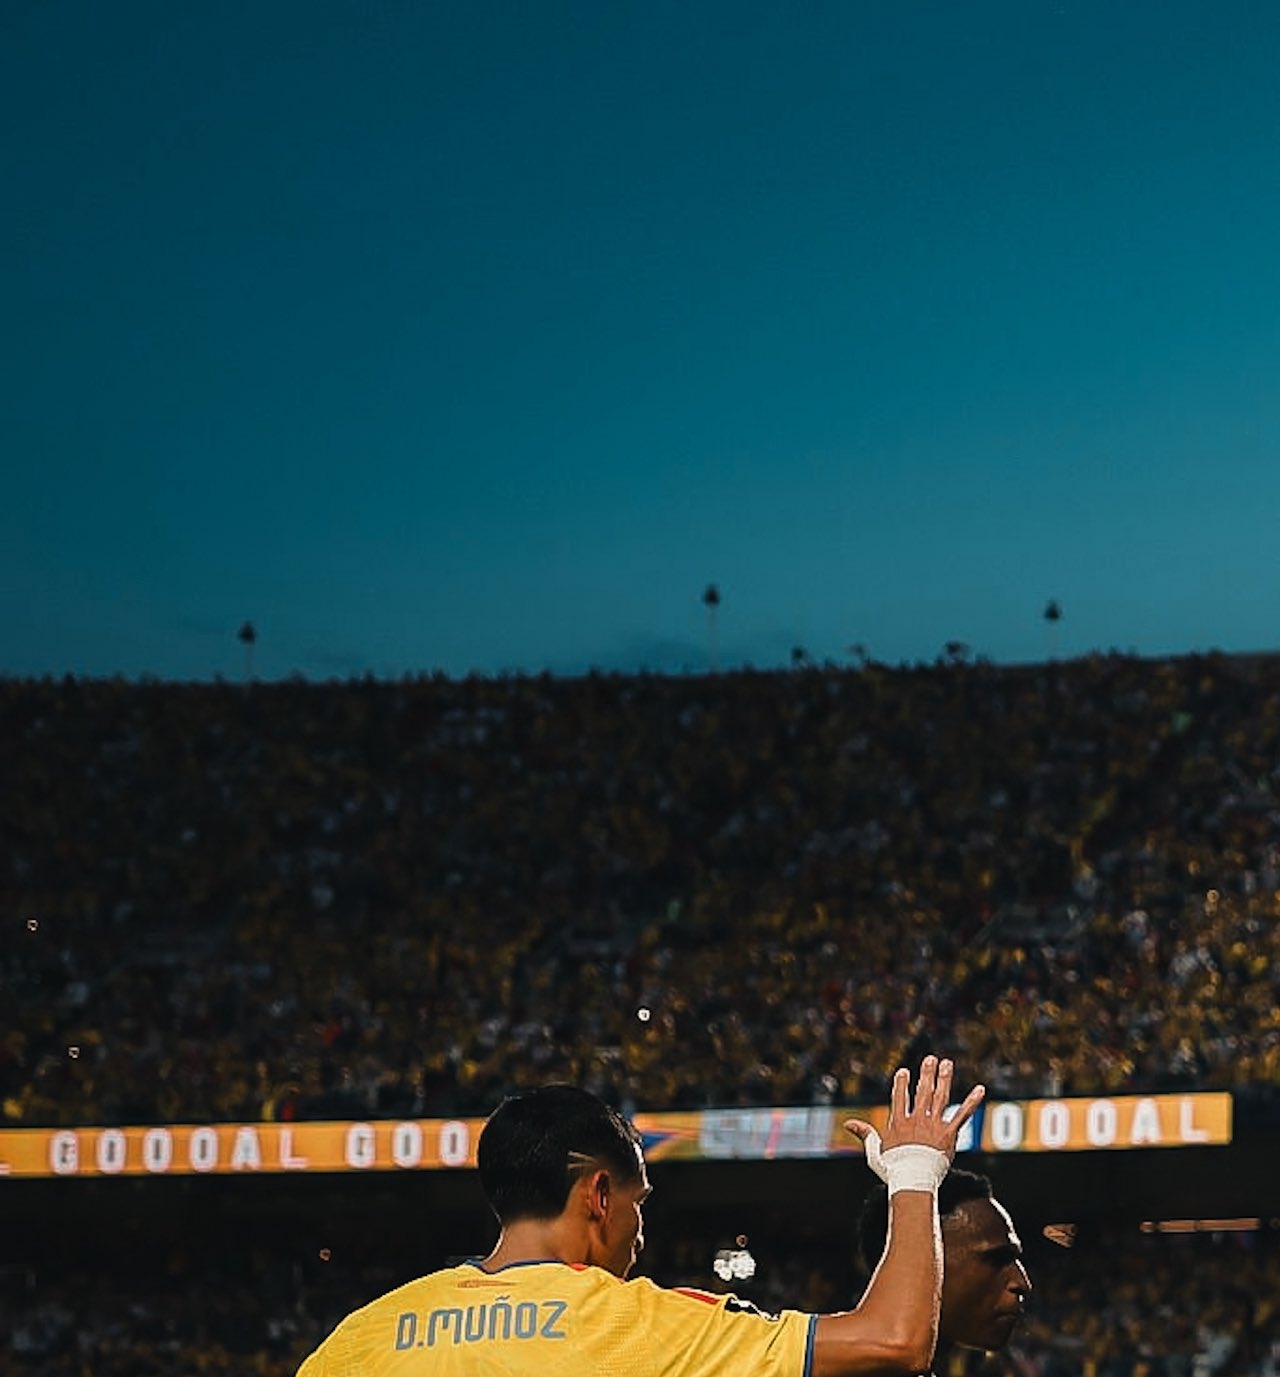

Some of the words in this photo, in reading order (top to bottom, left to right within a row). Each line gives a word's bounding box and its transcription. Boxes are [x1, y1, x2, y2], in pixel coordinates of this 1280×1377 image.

[51, 1126, 307, 1174] GOOOAL
[347, 1119, 470, 1169] GOO
[396, 1295, 567, 1350] D.MUÑOZ
